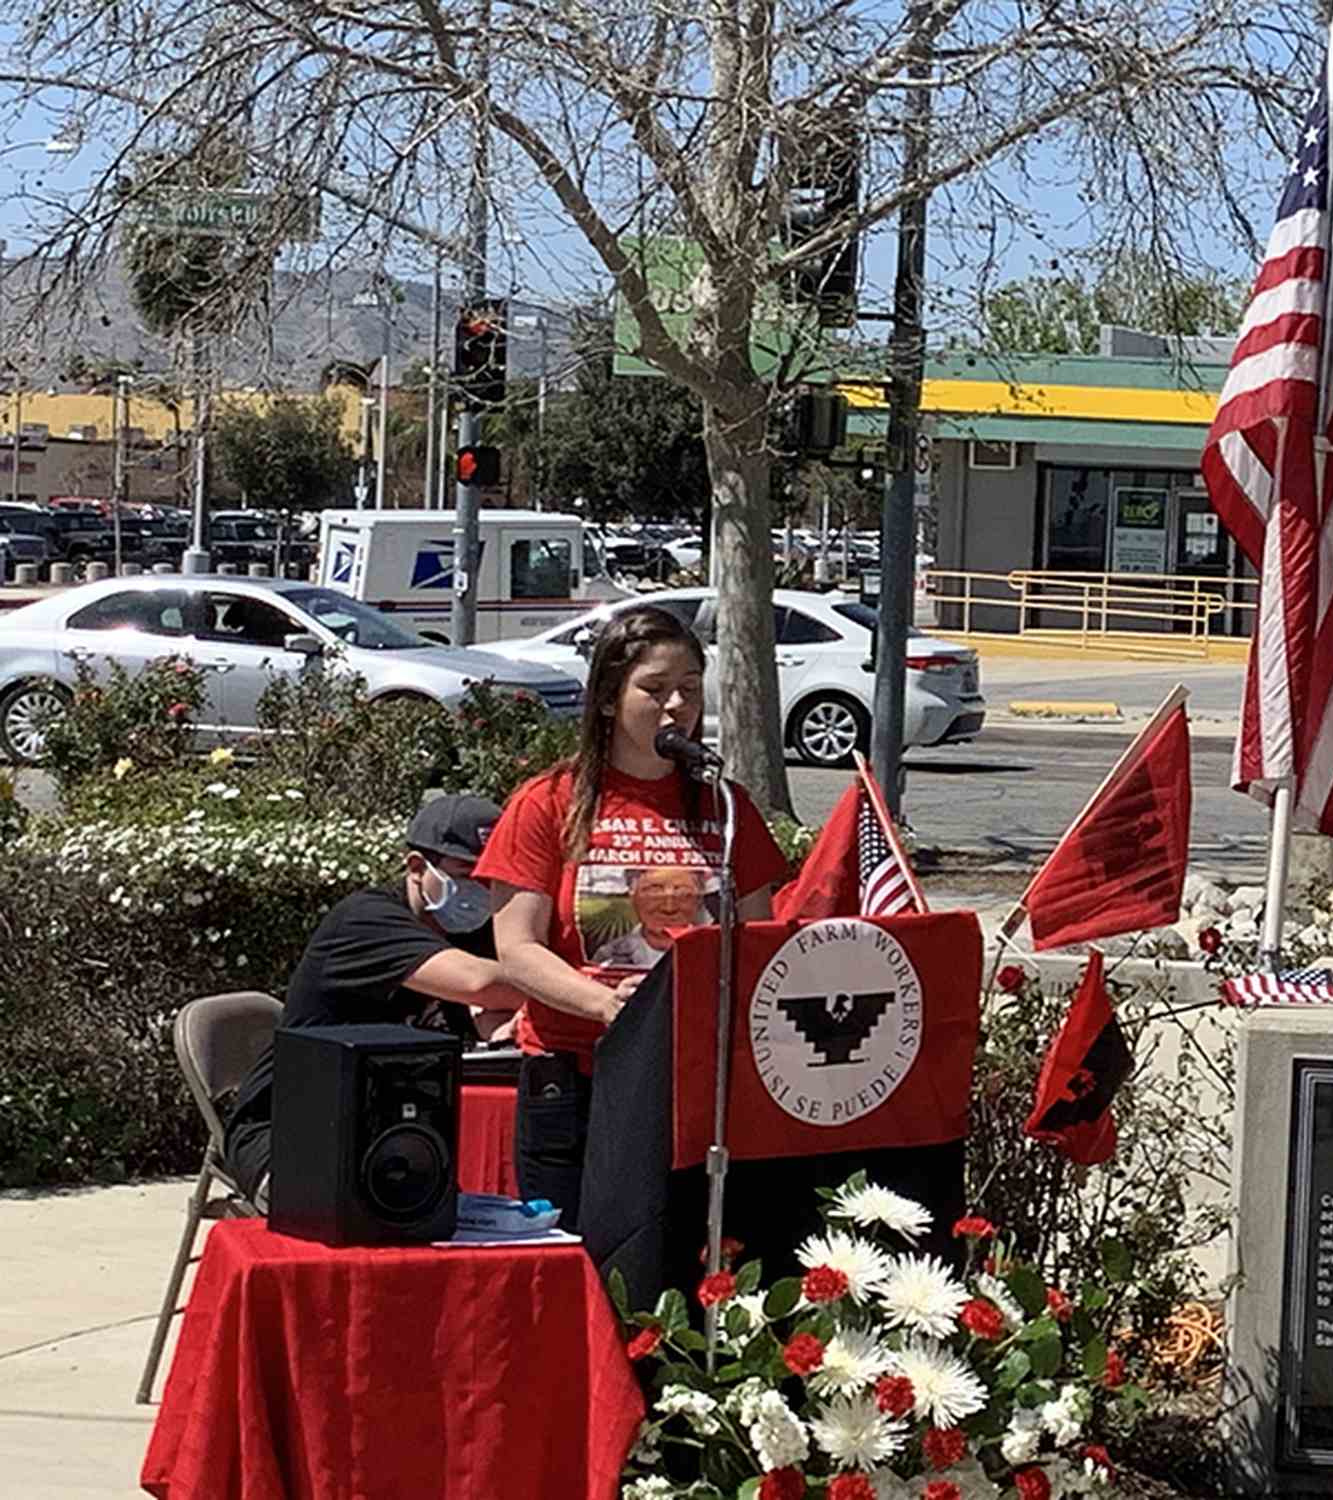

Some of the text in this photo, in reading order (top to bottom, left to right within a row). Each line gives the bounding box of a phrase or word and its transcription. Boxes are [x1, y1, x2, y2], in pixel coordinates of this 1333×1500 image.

[644, 851, 676, 864] FOR
[753, 922, 920, 1063] UNITED FARM WORKERS
[793, 1095, 823, 1120] SE
